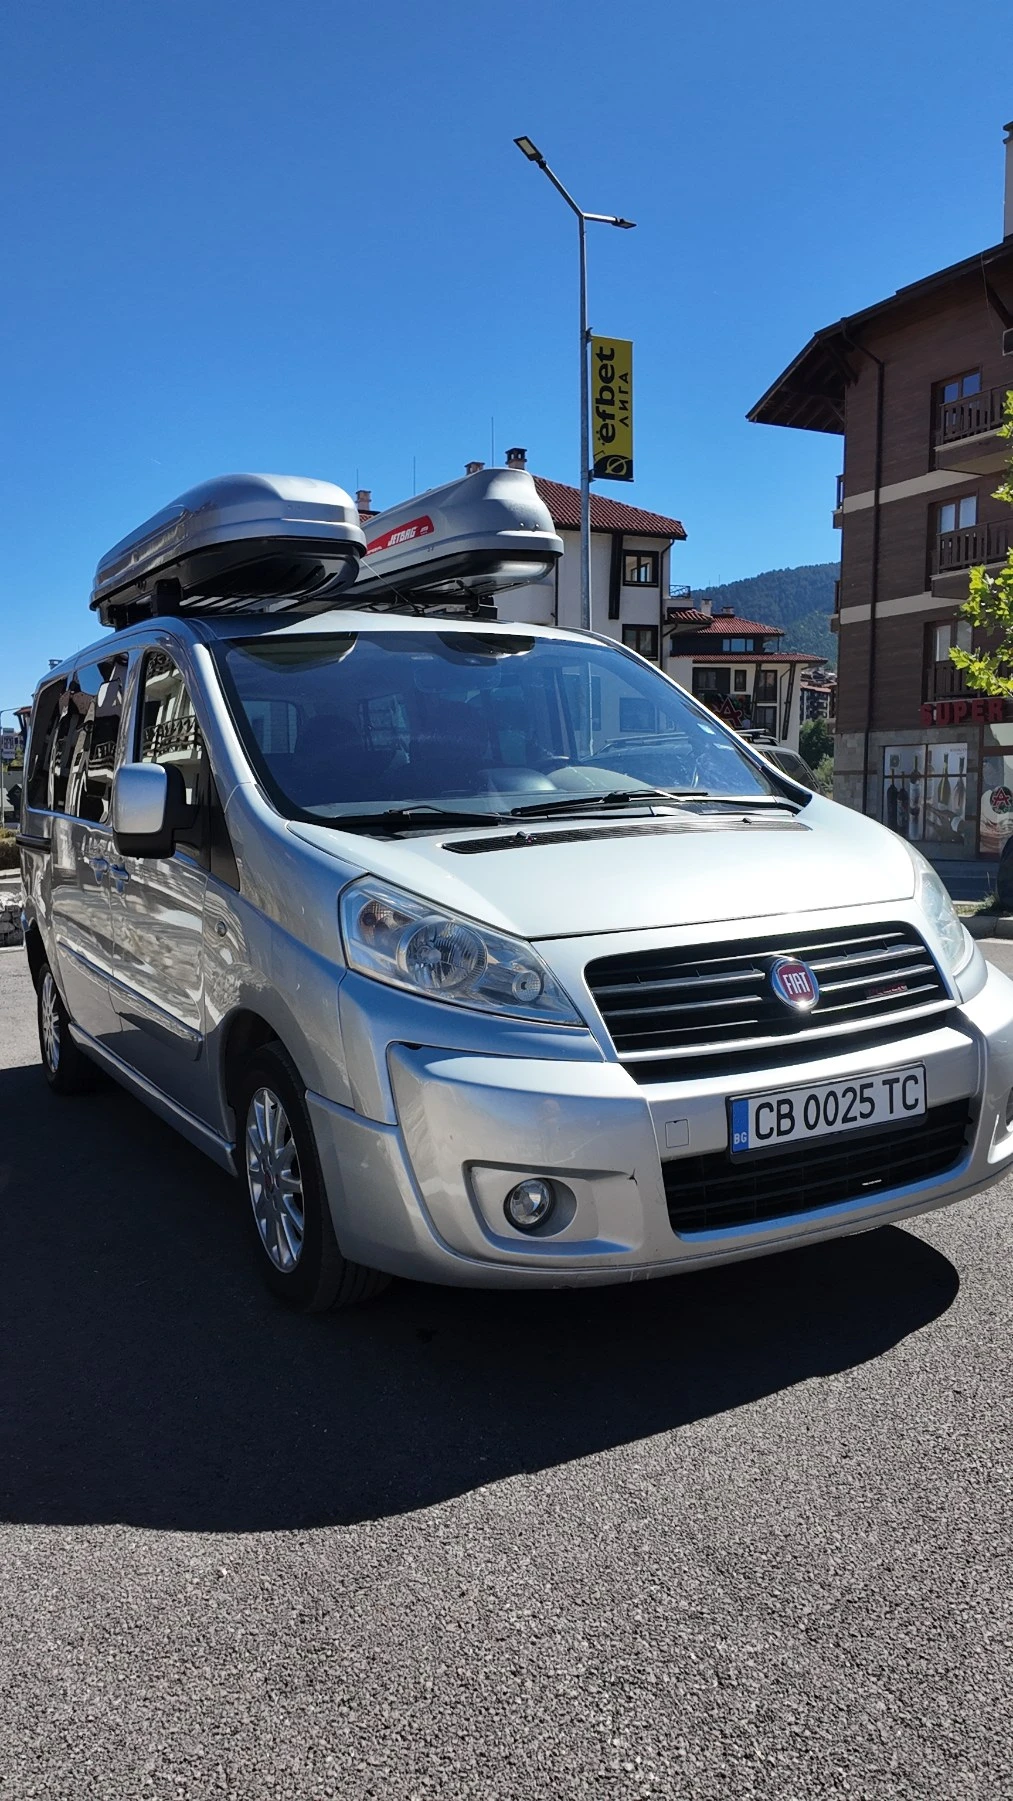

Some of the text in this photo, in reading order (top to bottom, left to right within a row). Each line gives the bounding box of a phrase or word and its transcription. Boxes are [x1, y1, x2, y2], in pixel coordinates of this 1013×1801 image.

[595, 346, 616, 443] efbet
[618, 372, 629, 427] ЛИГА
[919, 698, 1003, 726] SUPER
[782, 971, 809, 995] FIAT
[755, 1075, 919, 1140] CB 0025 TC
[733, 1132, 747, 1145] BG
